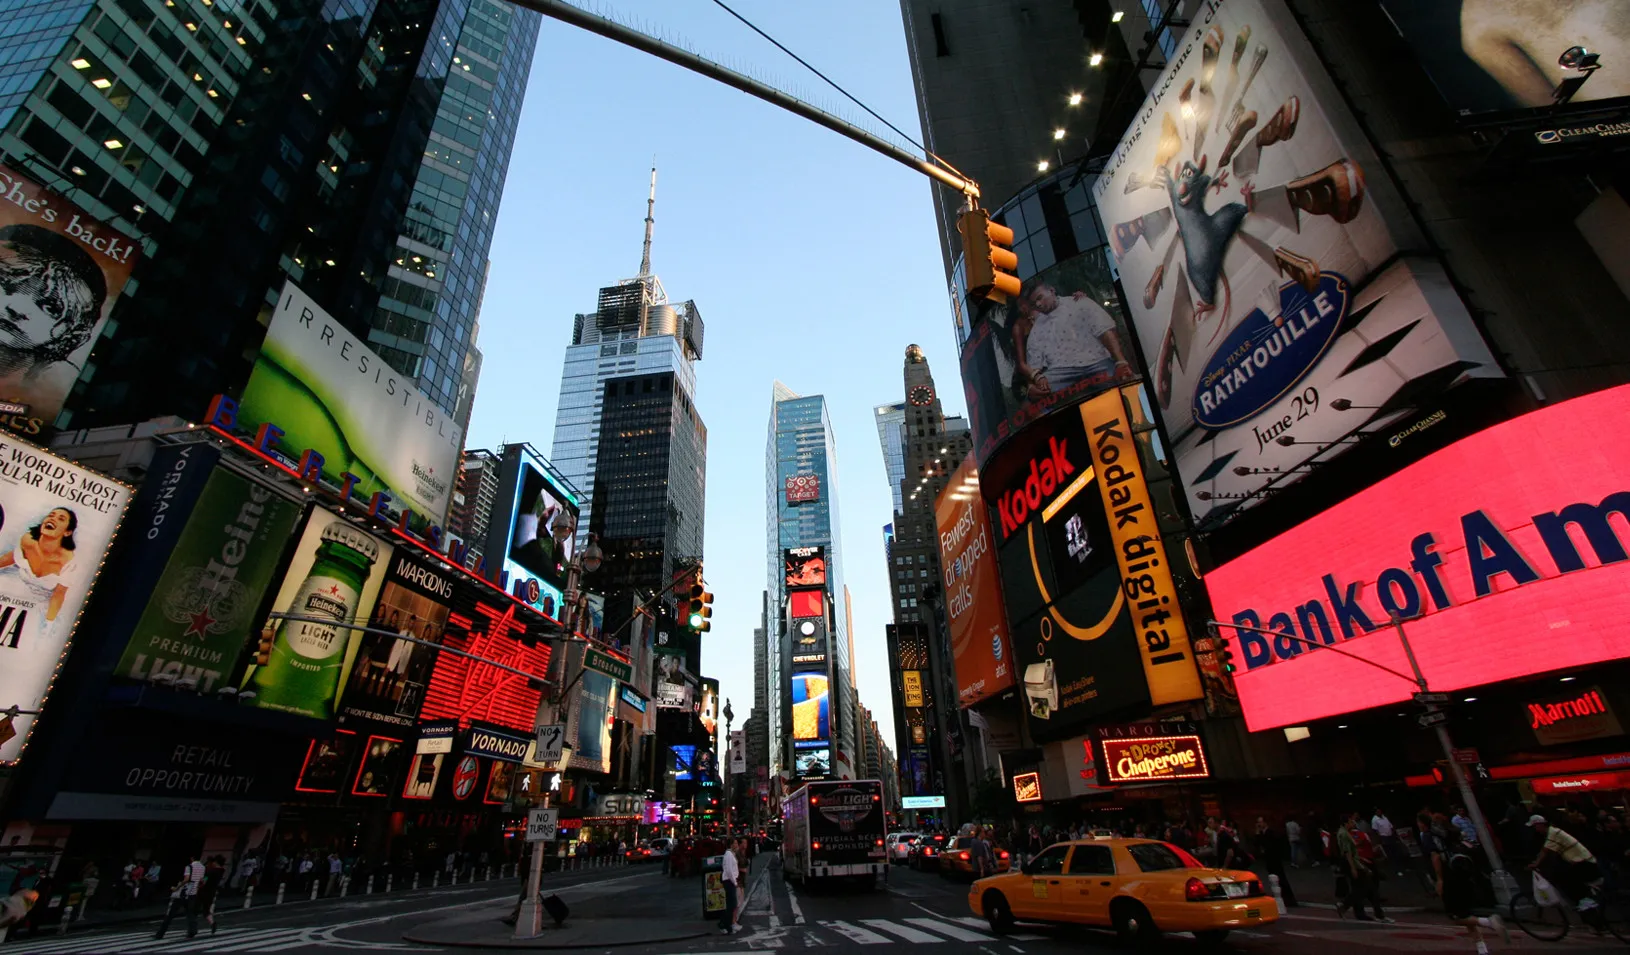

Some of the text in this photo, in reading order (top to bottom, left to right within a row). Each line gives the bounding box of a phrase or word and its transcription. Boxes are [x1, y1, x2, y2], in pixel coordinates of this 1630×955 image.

[1115, 128, 1143, 169] dying
[1141, 107, 1154, 126] to
[1151, 43, 1193, 107] become
[1195, 29, 1203, 42] a
[64, 214, 133, 265] back!
[1199, 291, 1336, 416] RATATOUILLE
[1226, 340, 1252, 367] PIXAR
[283, 294, 458, 449] IRRESISTIBLE
[1251, 386, 1320, 455] June 29
[11, 448, 75, 486] WORLD'S
[80, 477, 120, 502] MOST
[411, 463, 445, 495] Heineken
[998, 435, 1075, 539] Kodak
[147, 446, 193, 540] VORNADO
[789, 491, 816, 499] TARGET
[940, 502, 976, 557] Fewest
[1092, 418, 1145, 531] Kodak
[1122, 534, 1186, 666] digital
[1231, 490, 1630, 671] Bank of Am
[310, 597, 345, 618] Heineken
[949, 582, 973, 620] calls
[300, 624, 336, 645] LIGHT
[149, 635, 223, 664] PREMIUM
[129, 652, 222, 695] LIGHT
[592, 655, 627, 679] Broadway
[906, 684, 920, 692] LION
[907, 693, 921, 701] KING
[1528, 690, 1606, 730] Marriott
[471, 732, 526, 757] VORNADO
[540, 728, 552, 737] NO
[171, 743, 234, 768] RETAIL
[539, 751, 560, 759] TURN
[1117, 749, 1197, 778] Chaperone
[125, 767, 254, 794] OPPORTUNITY
[529, 824, 554, 834] TURNS
[536, 813, 549, 822] NO
[812, 835, 856, 843] OFFICIAL
